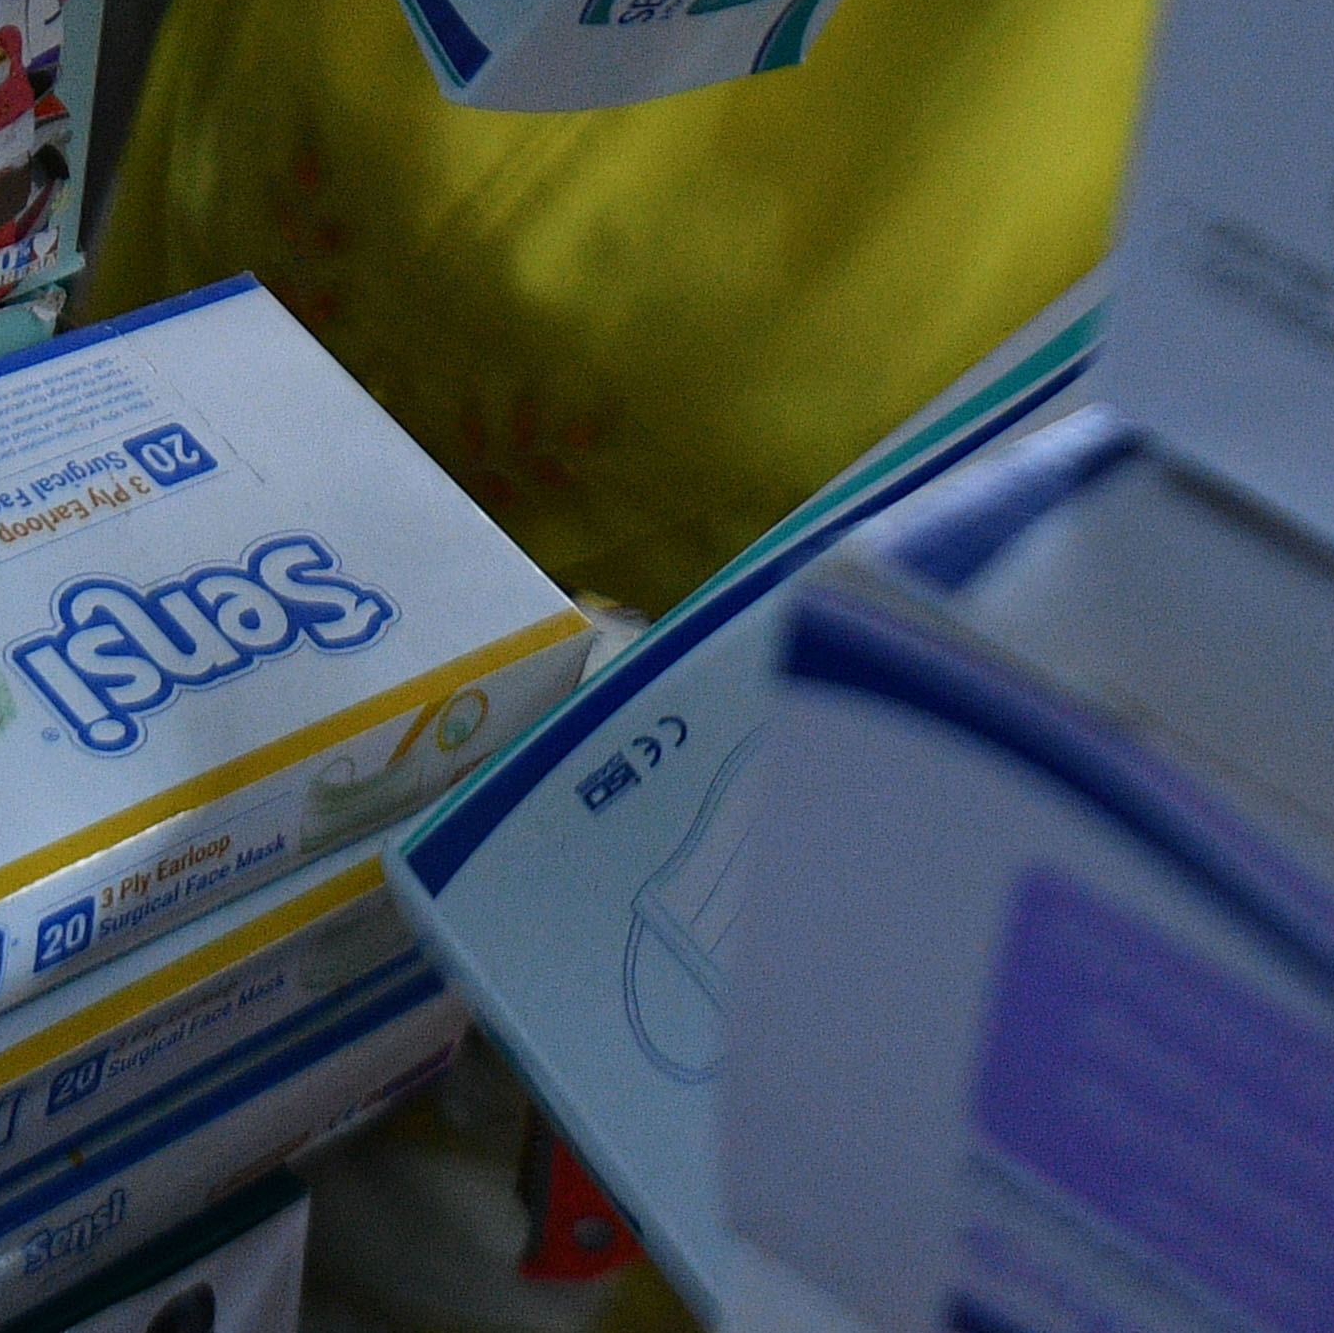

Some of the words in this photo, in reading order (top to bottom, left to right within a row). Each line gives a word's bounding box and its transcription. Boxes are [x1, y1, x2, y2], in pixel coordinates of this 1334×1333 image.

[35, 450, 127, 504] Surgical
[141, 432, 202, 475] 20
[89, 482, 137, 513] Ply
[130, 476, 150, 498] 3
[631, 716, 687, 768] CE
[100, 889, 180, 937] Surgical
[183, 863, 231, 897] Face
[235, 833, 288, 876] Mask
[101, 887, 115, 909] 3
[120, 869, 152, 901] Ply
[158, 833, 231, 880] Earloop
[44, 915, 87, 961] 20
[107, 1025, 185, 1079] Surgical
[186, 1003, 231, 1039] Face
[237, 972, 286, 1011] Mask
[51, 1055, 100, 1102] 20
